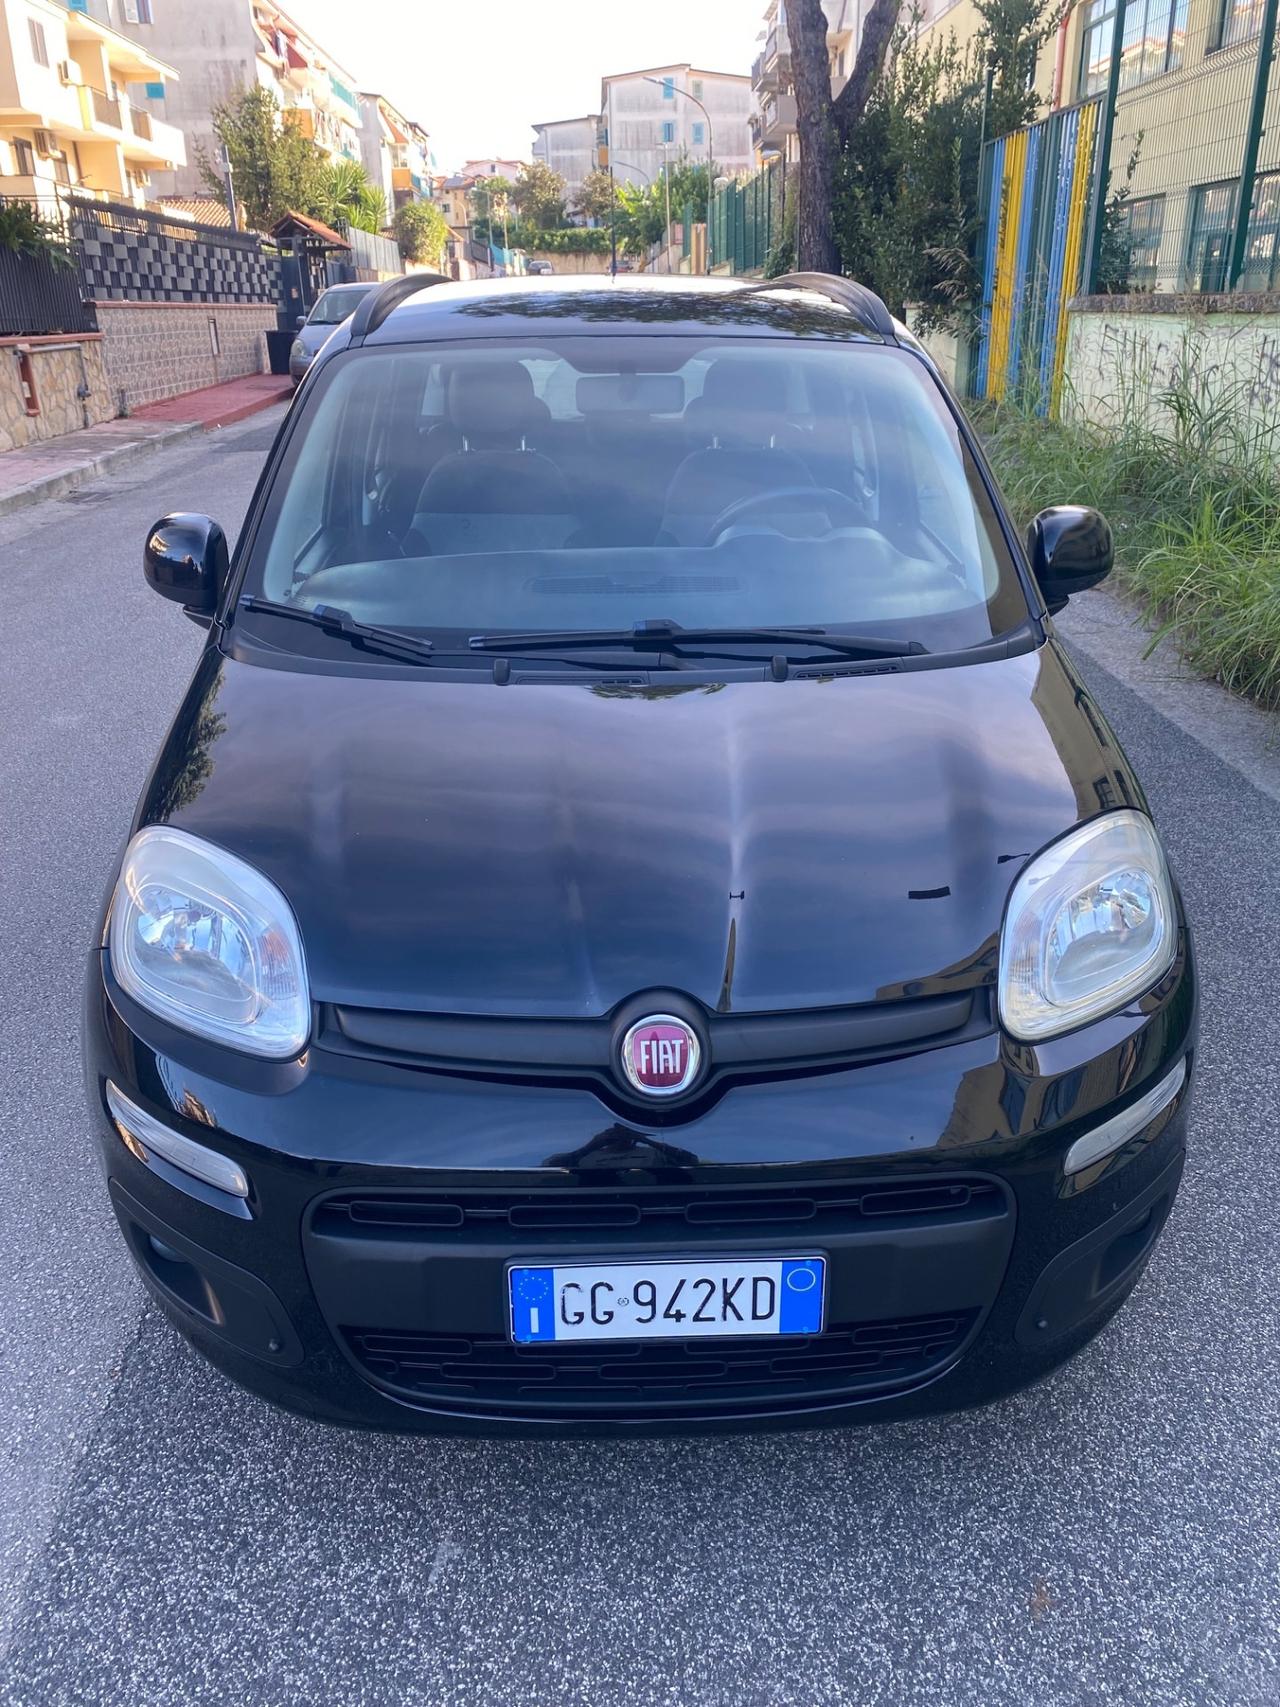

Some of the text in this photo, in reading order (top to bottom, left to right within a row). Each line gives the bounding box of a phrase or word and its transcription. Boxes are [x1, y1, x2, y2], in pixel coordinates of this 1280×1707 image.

[640, 1039, 684, 1074] FIAT
[560, 1276, 776, 1326] GG 942KD
